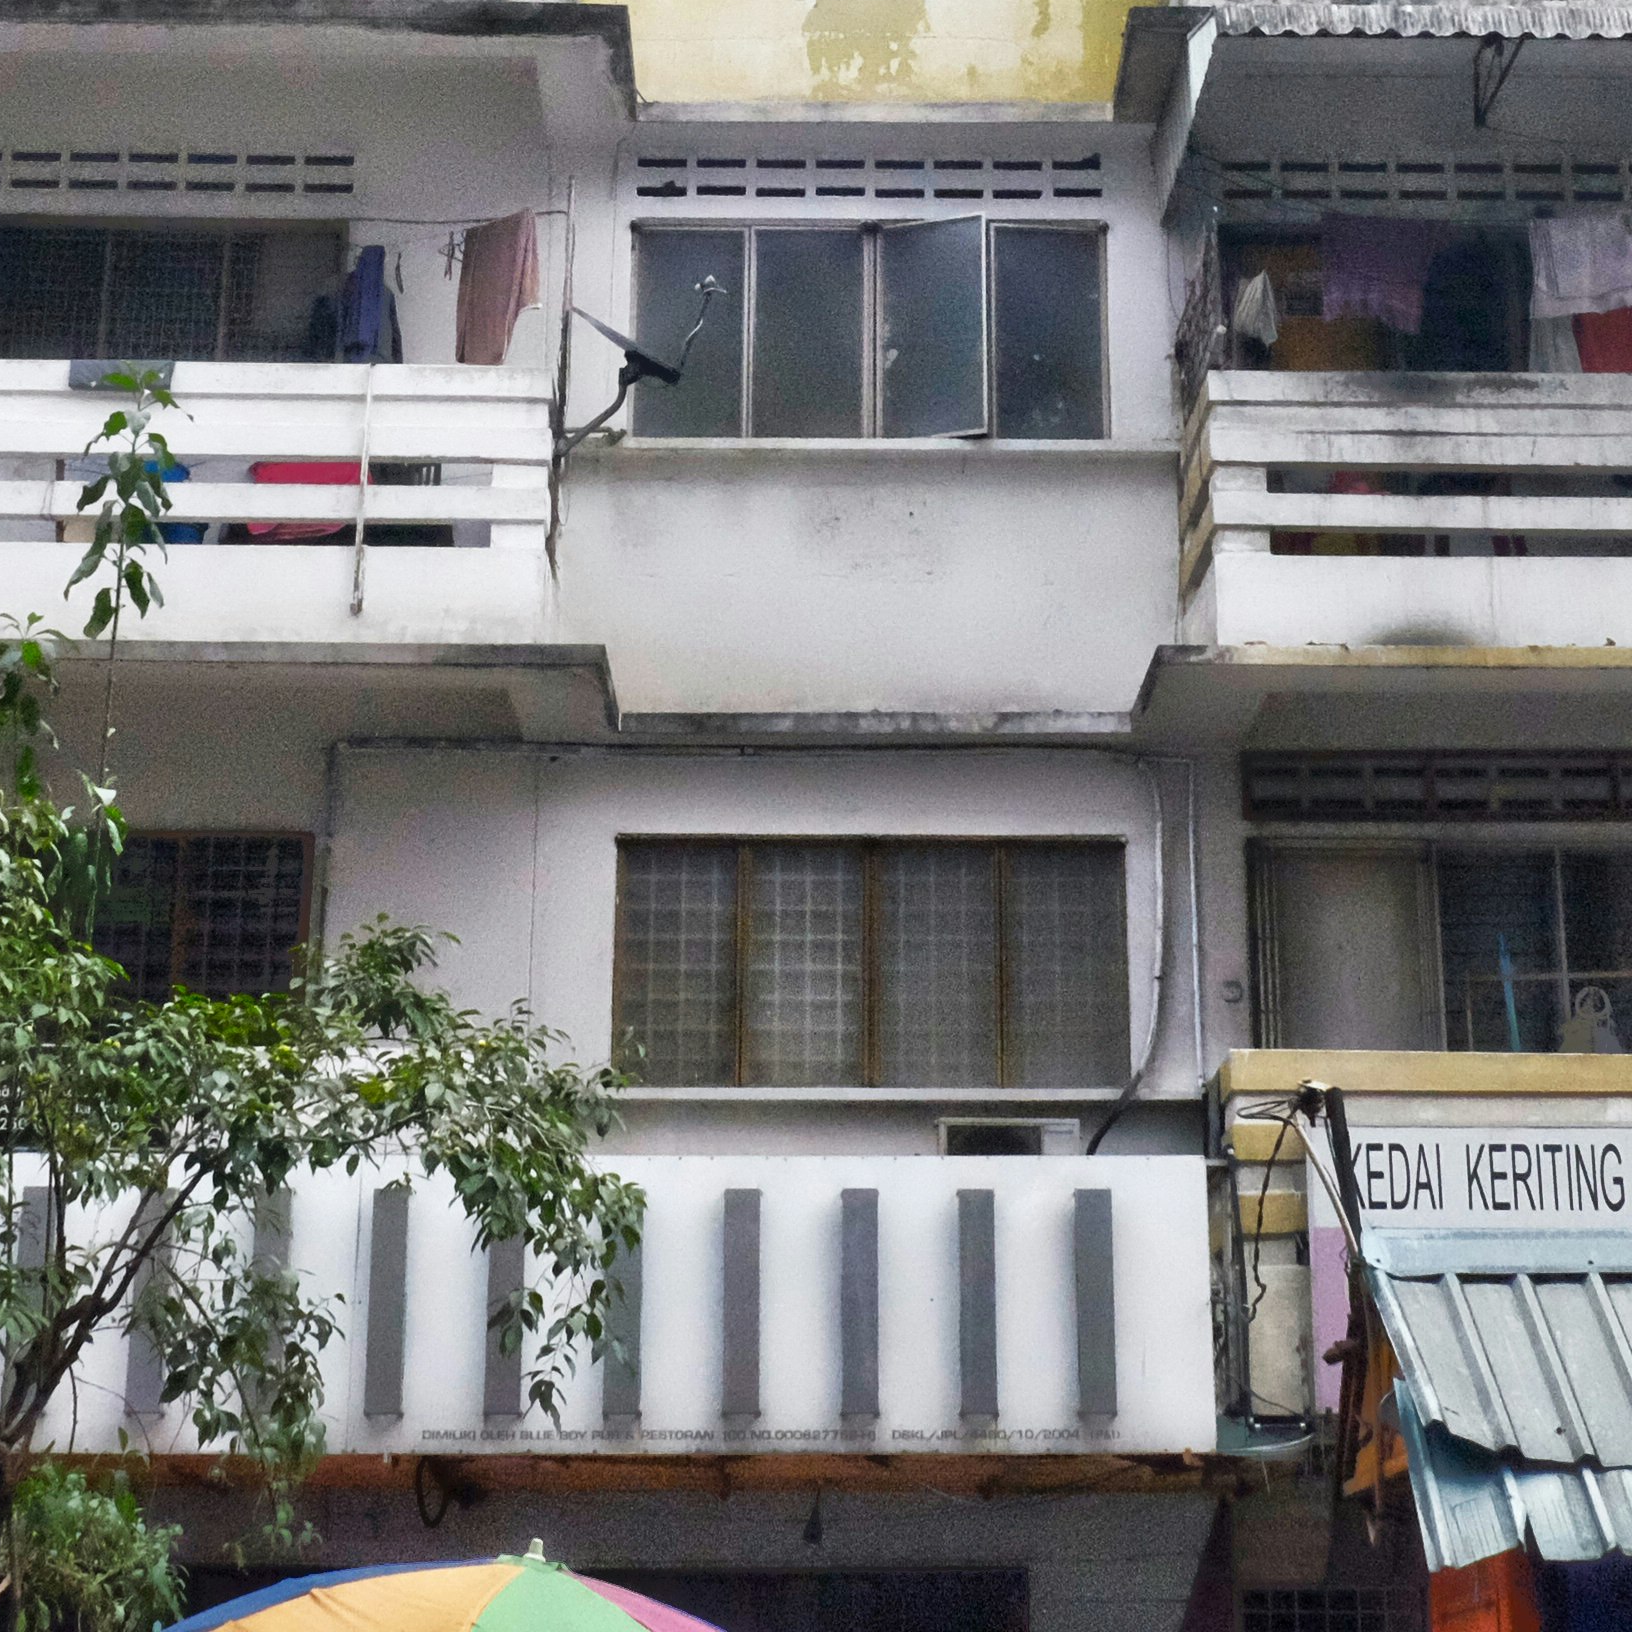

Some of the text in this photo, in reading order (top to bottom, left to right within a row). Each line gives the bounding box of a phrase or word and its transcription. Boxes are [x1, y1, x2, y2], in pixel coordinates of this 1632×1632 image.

[1465, 1142, 1626, 1212] KERITING
[421, 1429, 477, 1442] DIMILIKI
[479, 1429, 516, 1442] OLEH
[519, 1429, 556, 1442] BLUE
[559, 1429, 588, 1442] BOY
